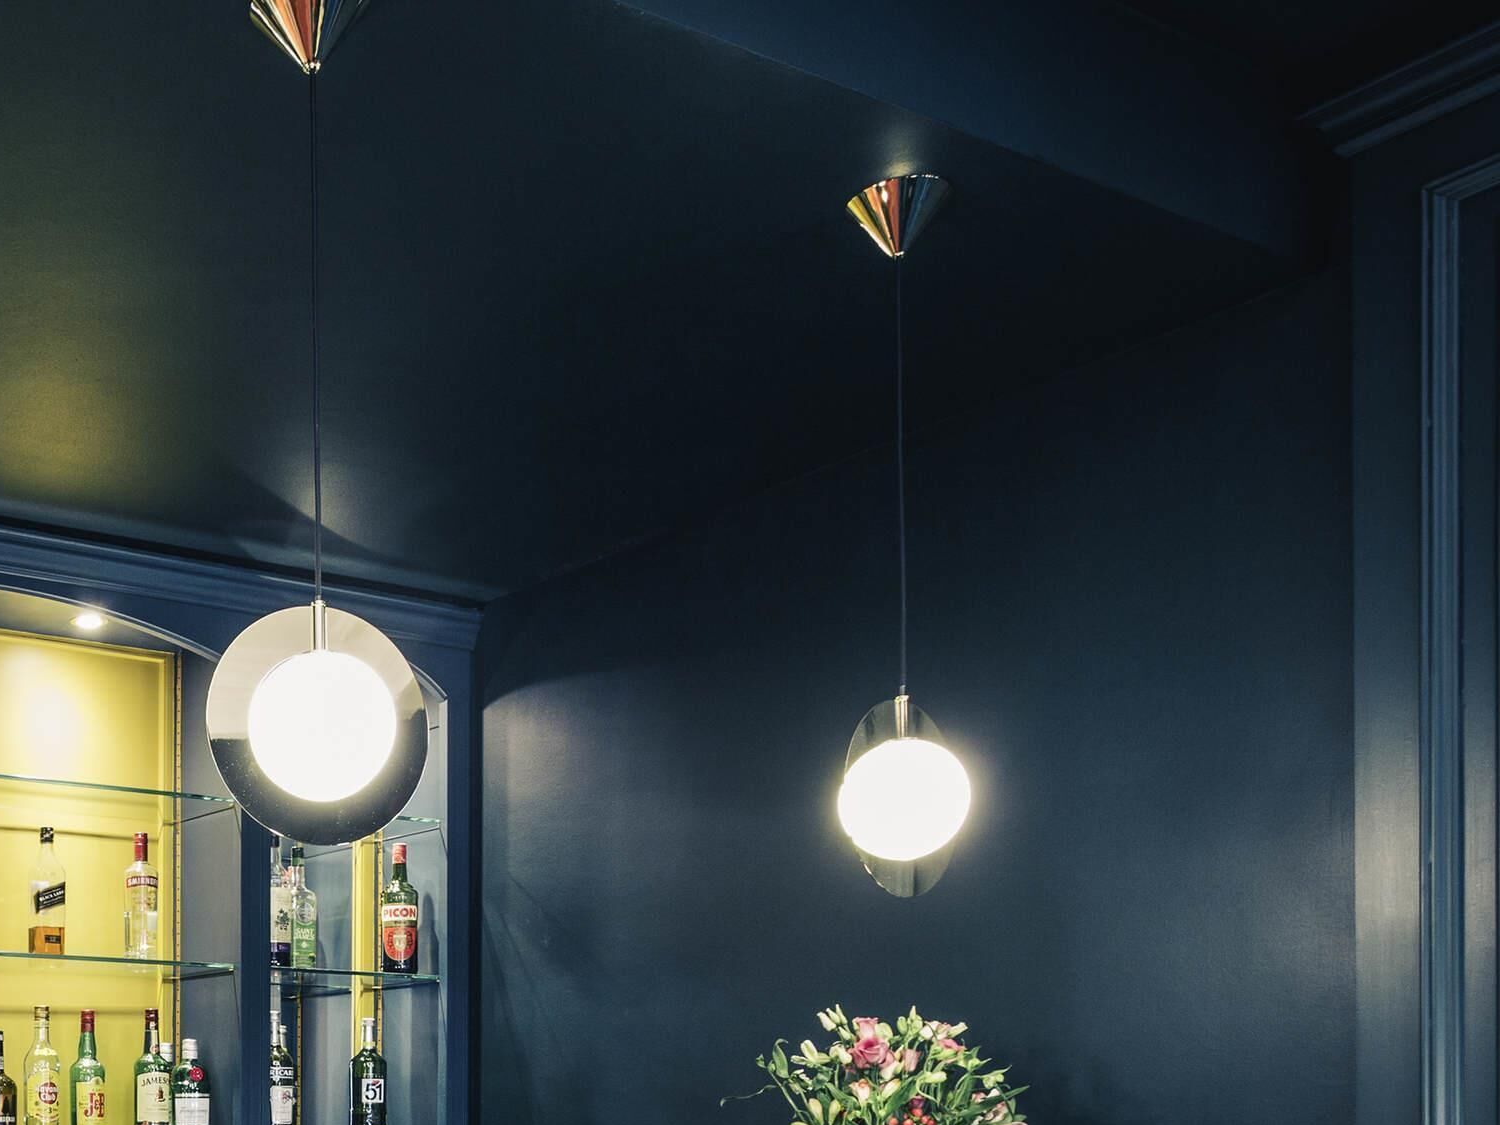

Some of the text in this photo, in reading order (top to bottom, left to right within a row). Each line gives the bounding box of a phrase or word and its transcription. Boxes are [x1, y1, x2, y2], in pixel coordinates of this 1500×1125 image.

[383, 907, 416, 918] PICON
[364, 1083, 382, 1101] 51
[84, 1092, 105, 1118] J&B
